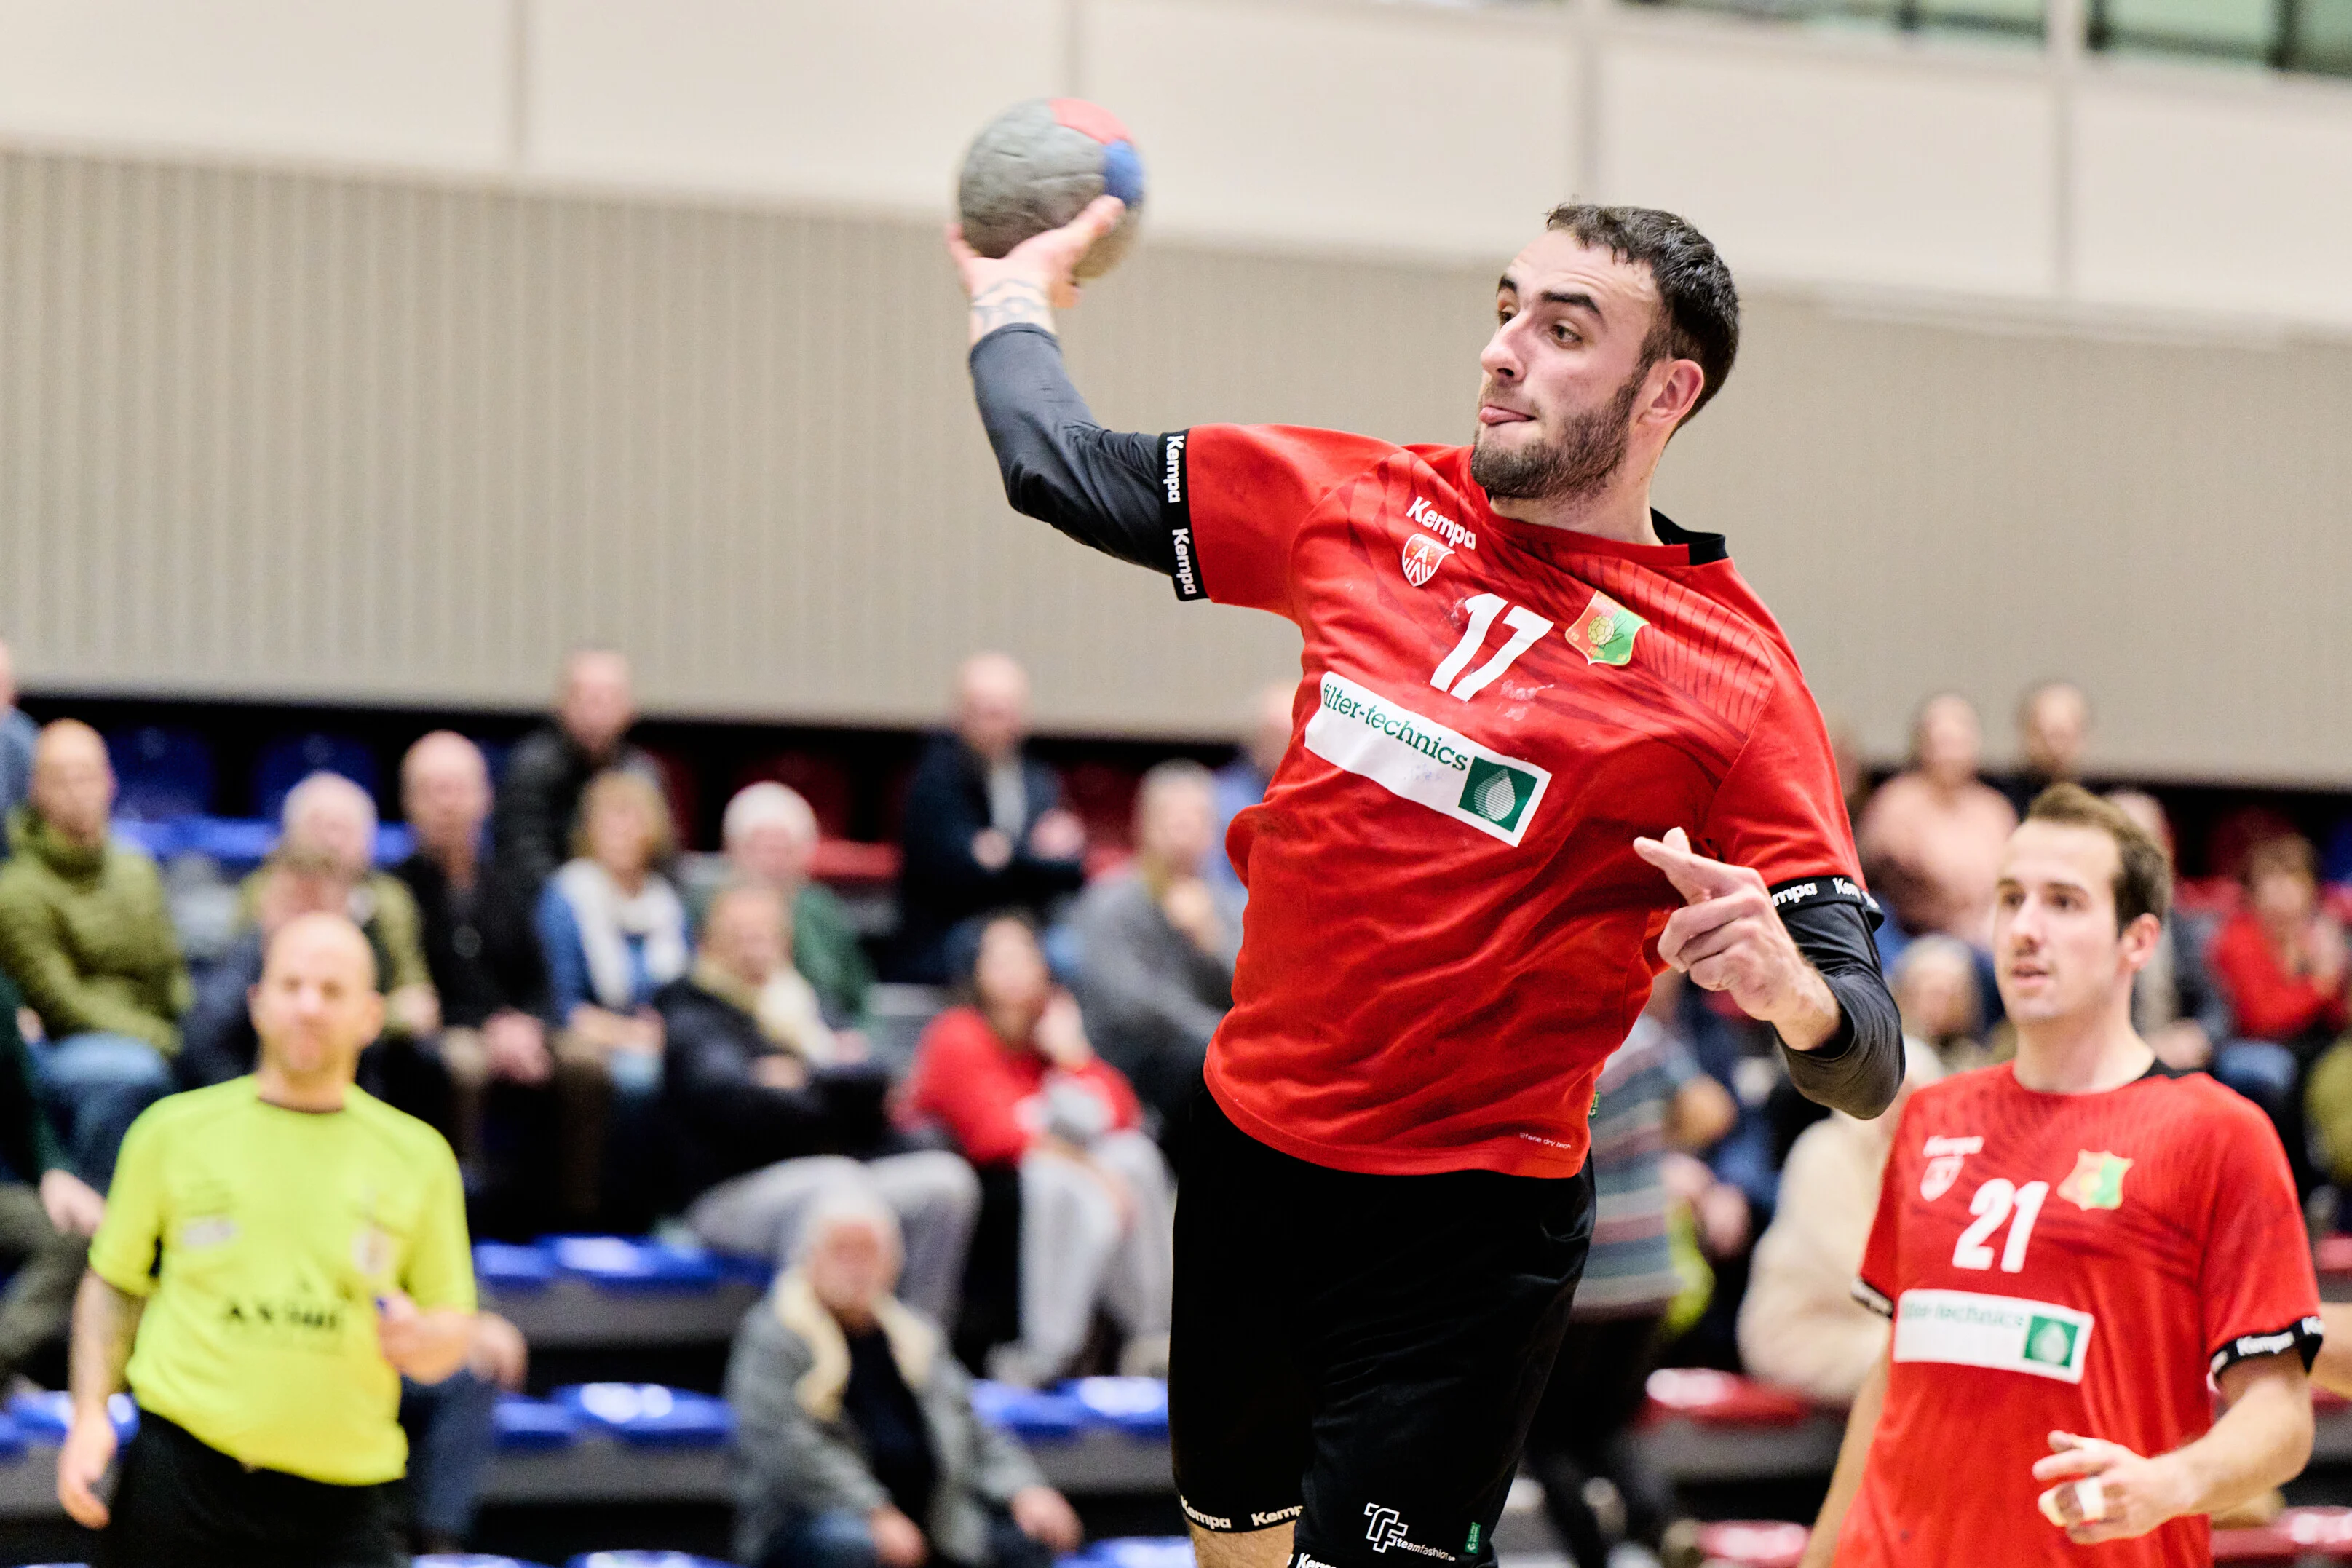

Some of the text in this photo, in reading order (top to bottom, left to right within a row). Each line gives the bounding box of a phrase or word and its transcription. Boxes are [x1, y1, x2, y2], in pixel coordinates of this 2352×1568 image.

[1163, 435, 1185, 504] Kempa
[1406, 496, 1476, 550] Kempa
[1172, 528, 1197, 595] Kempa
[1430, 592, 1555, 702] 17
[1323, 683, 1468, 772] filter-technics
[1771, 882, 1818, 908] mpa
[1952, 1177, 2050, 1274] 21
[1180, 1494, 1232, 1530] Kempa
[1250, 1505, 1304, 1527] Kemp
